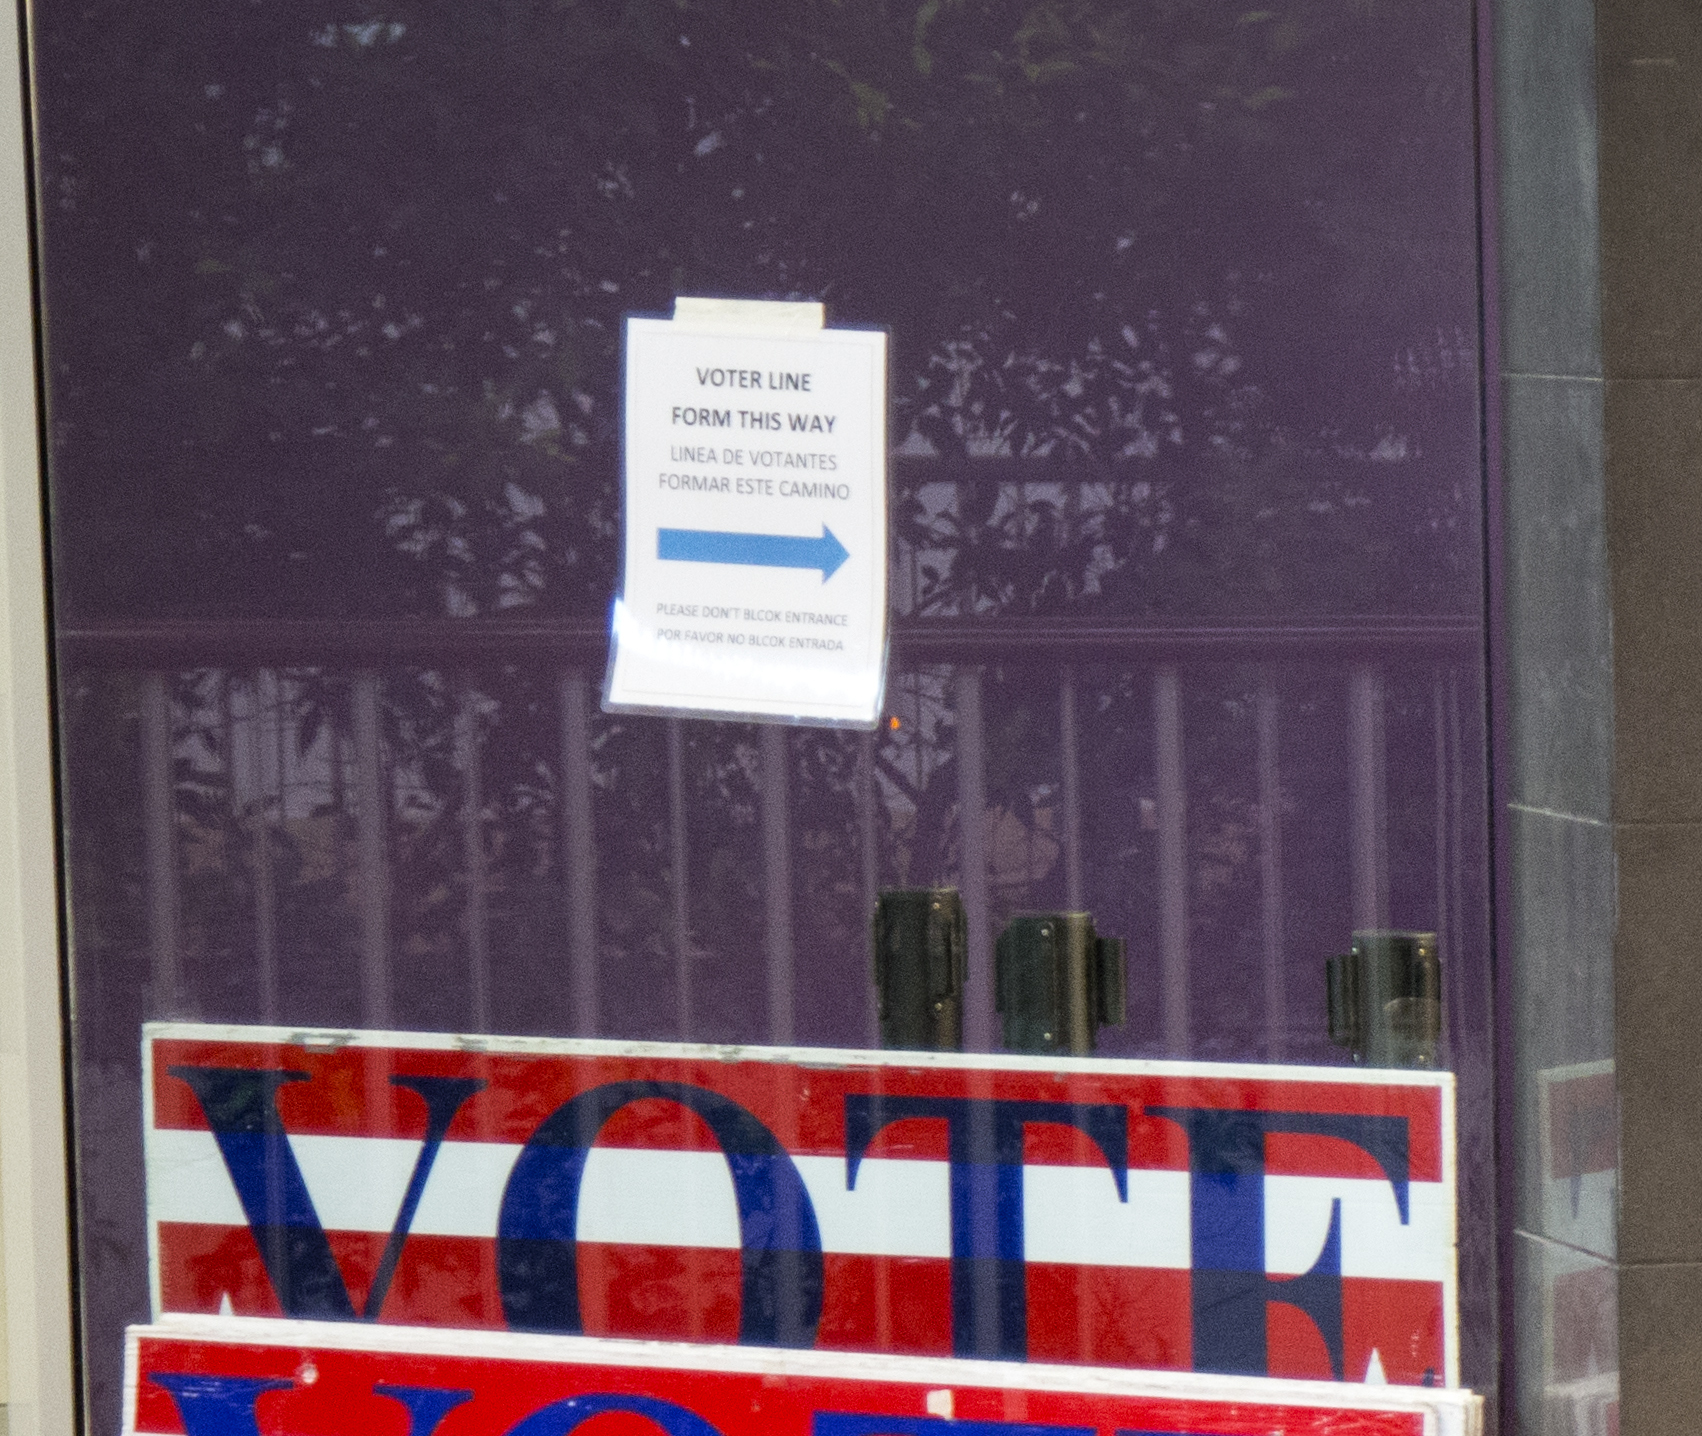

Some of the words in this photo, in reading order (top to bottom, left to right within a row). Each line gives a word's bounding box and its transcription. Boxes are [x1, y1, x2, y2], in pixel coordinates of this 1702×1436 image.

[696, 367, 762, 389] VOTER
[769, 372, 811, 392] LINE
[671, 407, 731, 429] FORM
[739, 410, 782, 432] THIS
[787, 413, 836, 434] WAY
[670, 445, 716, 465] LINEA
[723, 448, 744, 466] DE
[749, 449, 838, 471] VOTANTES
[658, 473, 731, 494] FORMAR
[736, 477, 774, 497] ESTE
[778, 479, 850, 501] CAMINO
[656, 602, 699, 618] PLEASE
[702, 605, 741, 620] DON'T
[743, 607, 782, 623] BLCOK
[784, 610, 848, 627] ENTRANCE
[657, 627, 681, 642] POR
[684, 629, 723, 645] FAVOR
[727, 632, 746, 645] NO
[748, 633, 786, 648] BLCOK
[788, 636, 843, 652] ENTRADA
[168, 1065, 1410, 1386] VOTE
